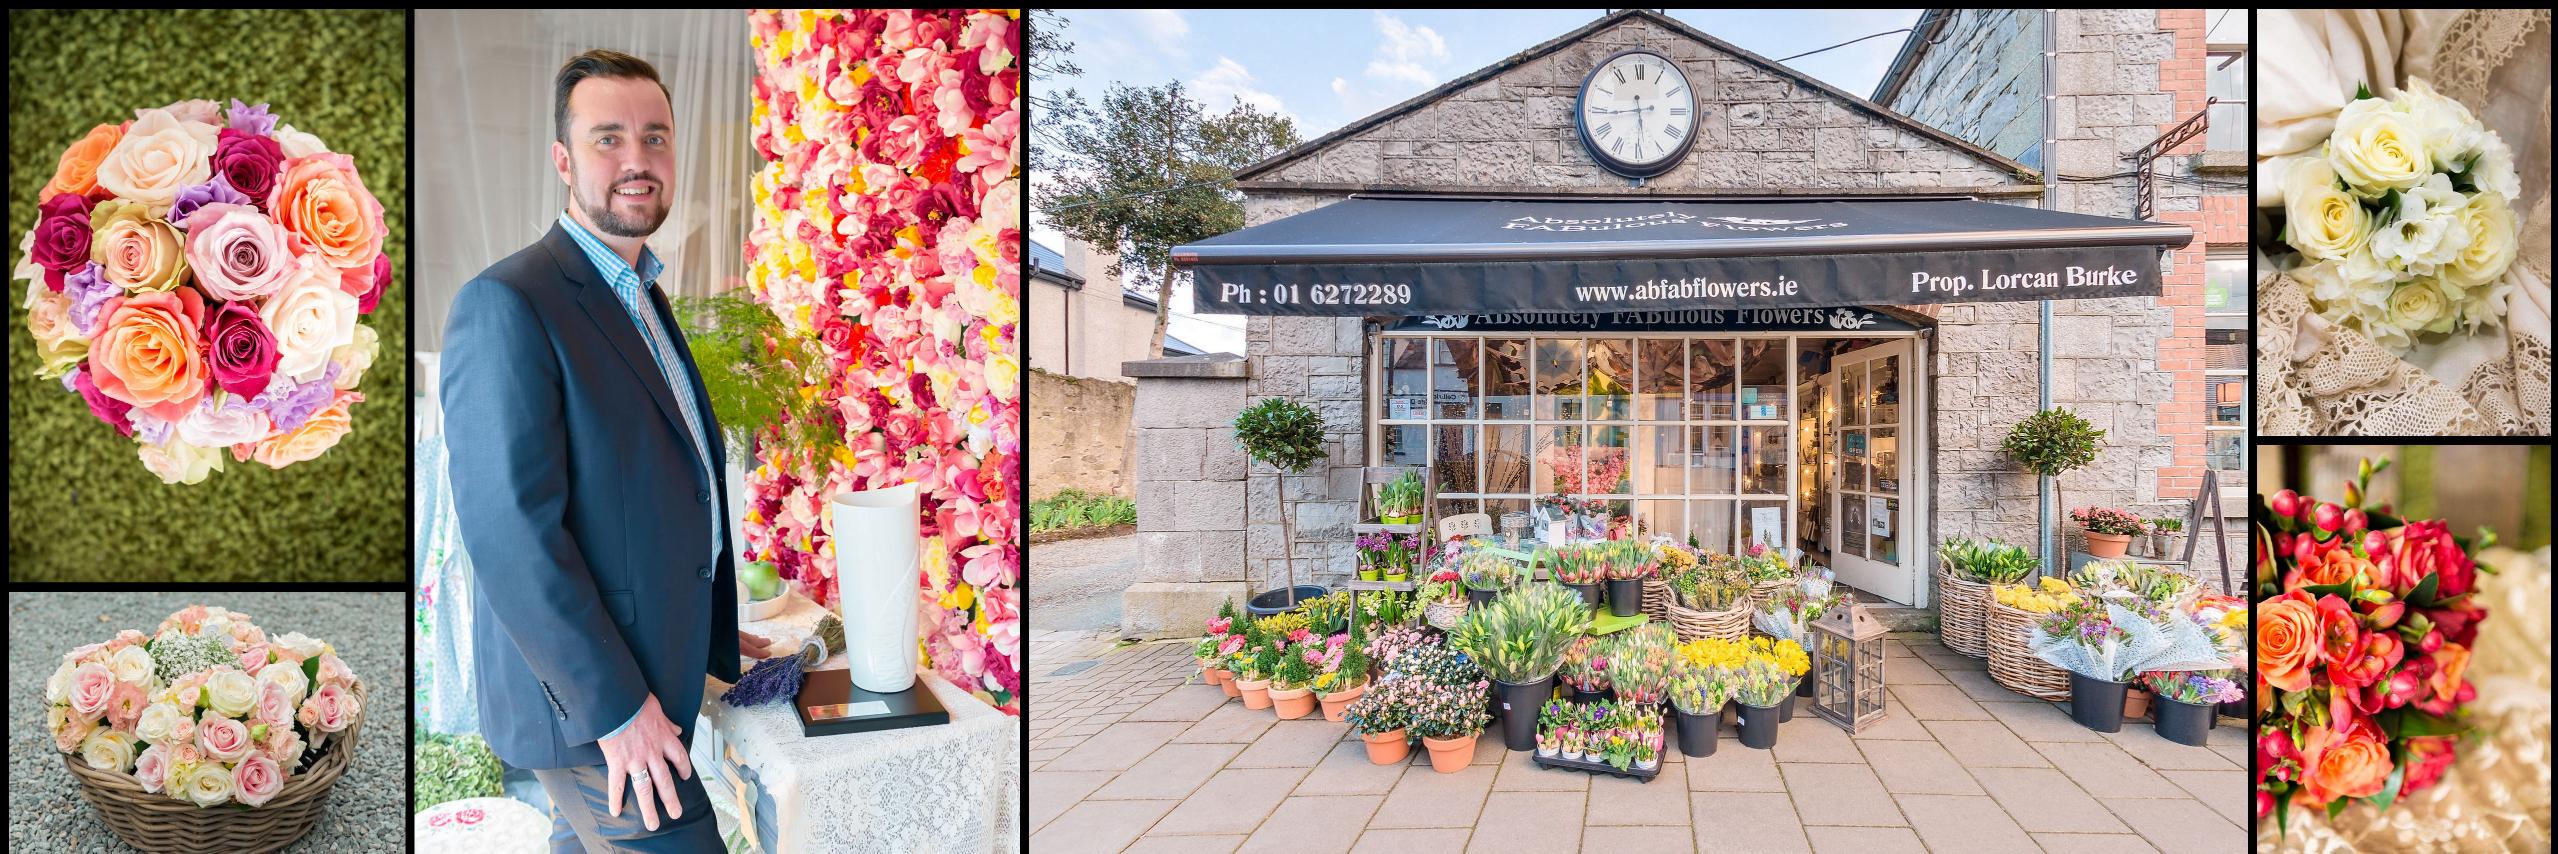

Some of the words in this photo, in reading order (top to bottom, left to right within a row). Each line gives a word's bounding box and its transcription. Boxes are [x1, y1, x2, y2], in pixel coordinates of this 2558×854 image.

[1220, 282, 1251, 304] Ph
[1272, 283, 1301, 305] 01
[1309, 283, 1412, 305] 6272289
[1576, 274, 1799, 302] www.abfabflowers.ie
[1911, 271, 1975, 297] Prop.
[1981, 268, 2059, 291] Lorcan
[2065, 264, 2138, 288] Burke
